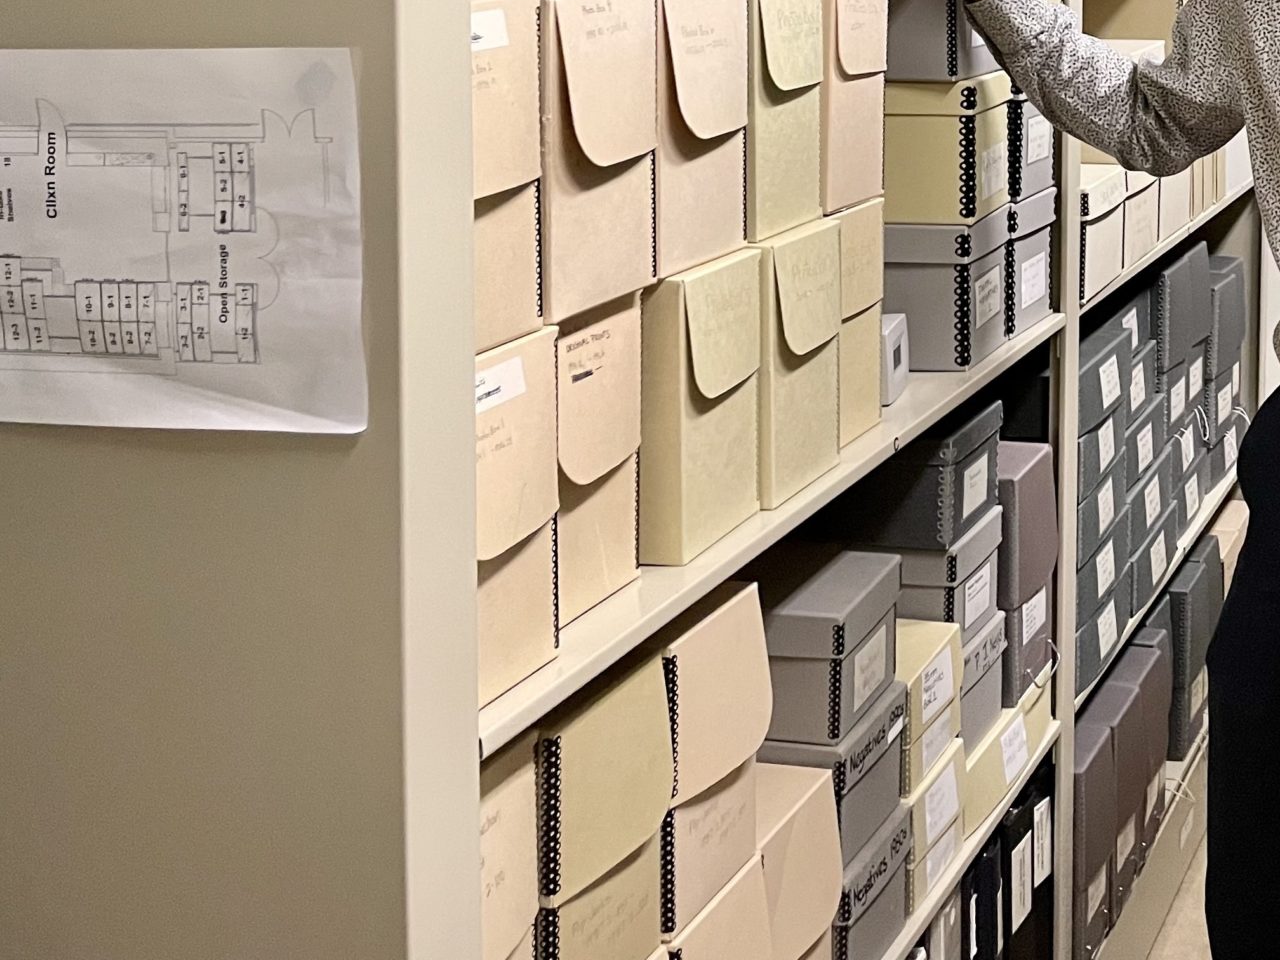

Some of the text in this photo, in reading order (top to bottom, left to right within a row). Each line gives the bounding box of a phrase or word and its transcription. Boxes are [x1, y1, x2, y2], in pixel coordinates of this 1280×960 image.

[45, 132, 56, 176] Room
[238, 195, 246, 208] 4-2
[218, 244, 229, 323] Open Storage
[85, 296, 93, 313] 10-1
[34, 327, 42, 344] 11-2
[144, 332, 152, 345] 7-2
[849, 719, 886, 775] Negatives
[852, 855, 888, 908] Negatives
